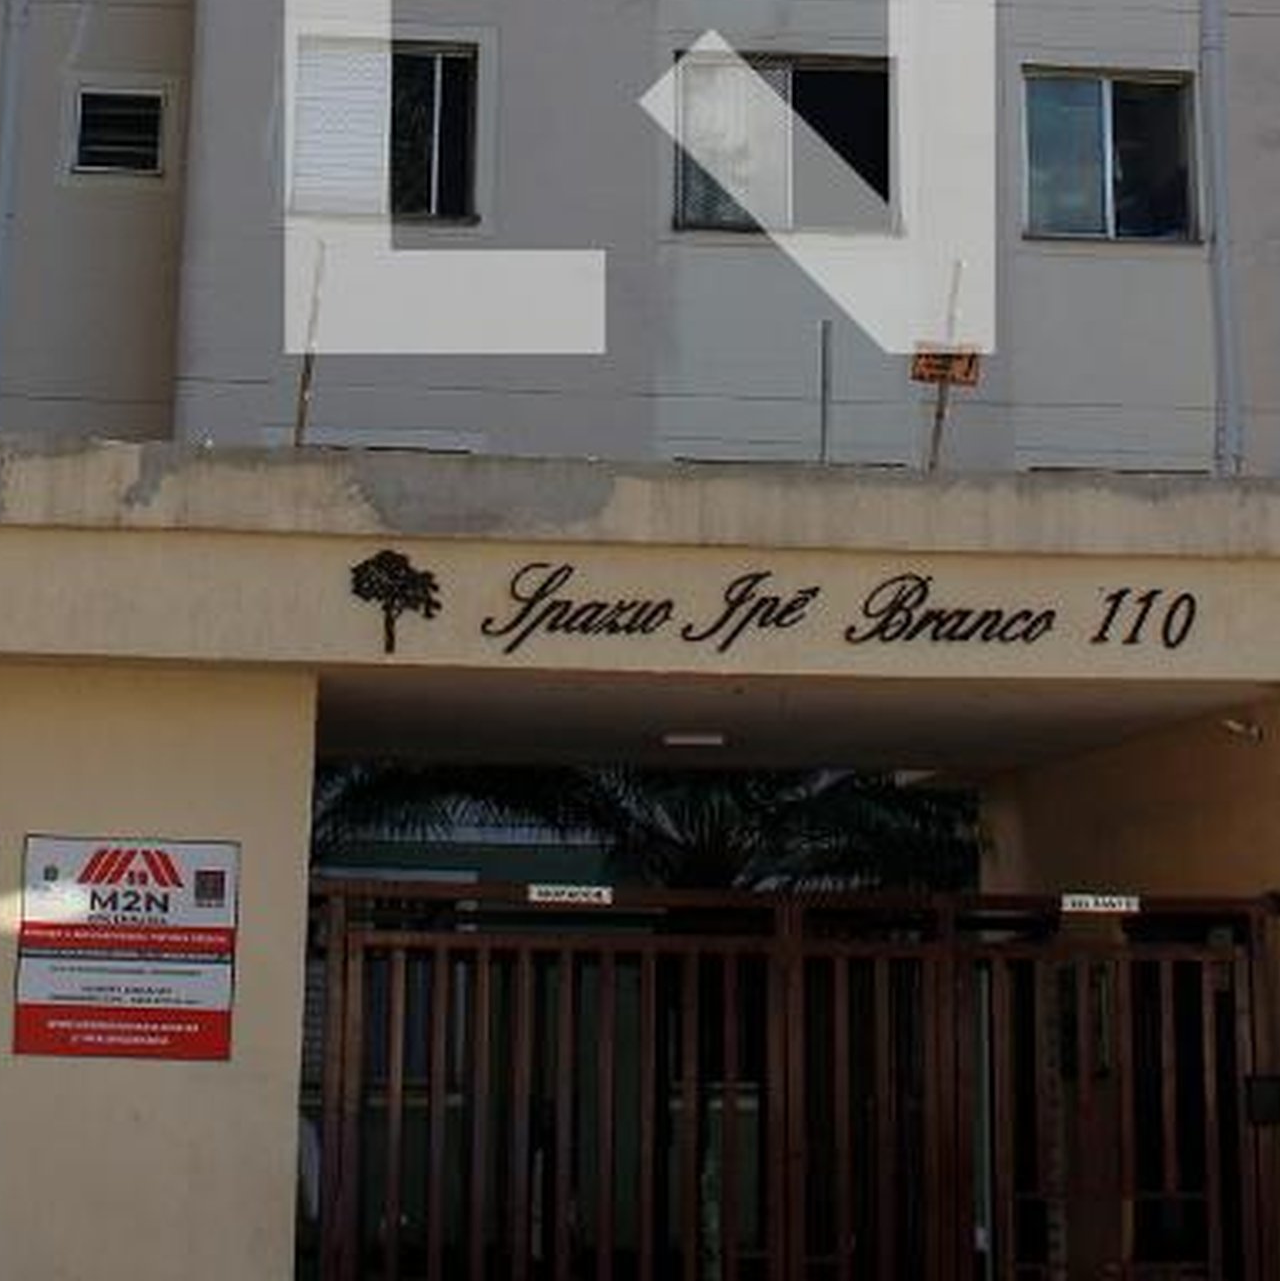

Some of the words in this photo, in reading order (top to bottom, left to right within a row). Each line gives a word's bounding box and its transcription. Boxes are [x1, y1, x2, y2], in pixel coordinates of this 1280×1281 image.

[481, 562, 675, 654] Spazio
[681, 570, 821, 654] Ipê
[844, 572, 1057, 645] Branco
[1090, 587, 1197, 650] 110
[89, 888, 170, 913] M2N
